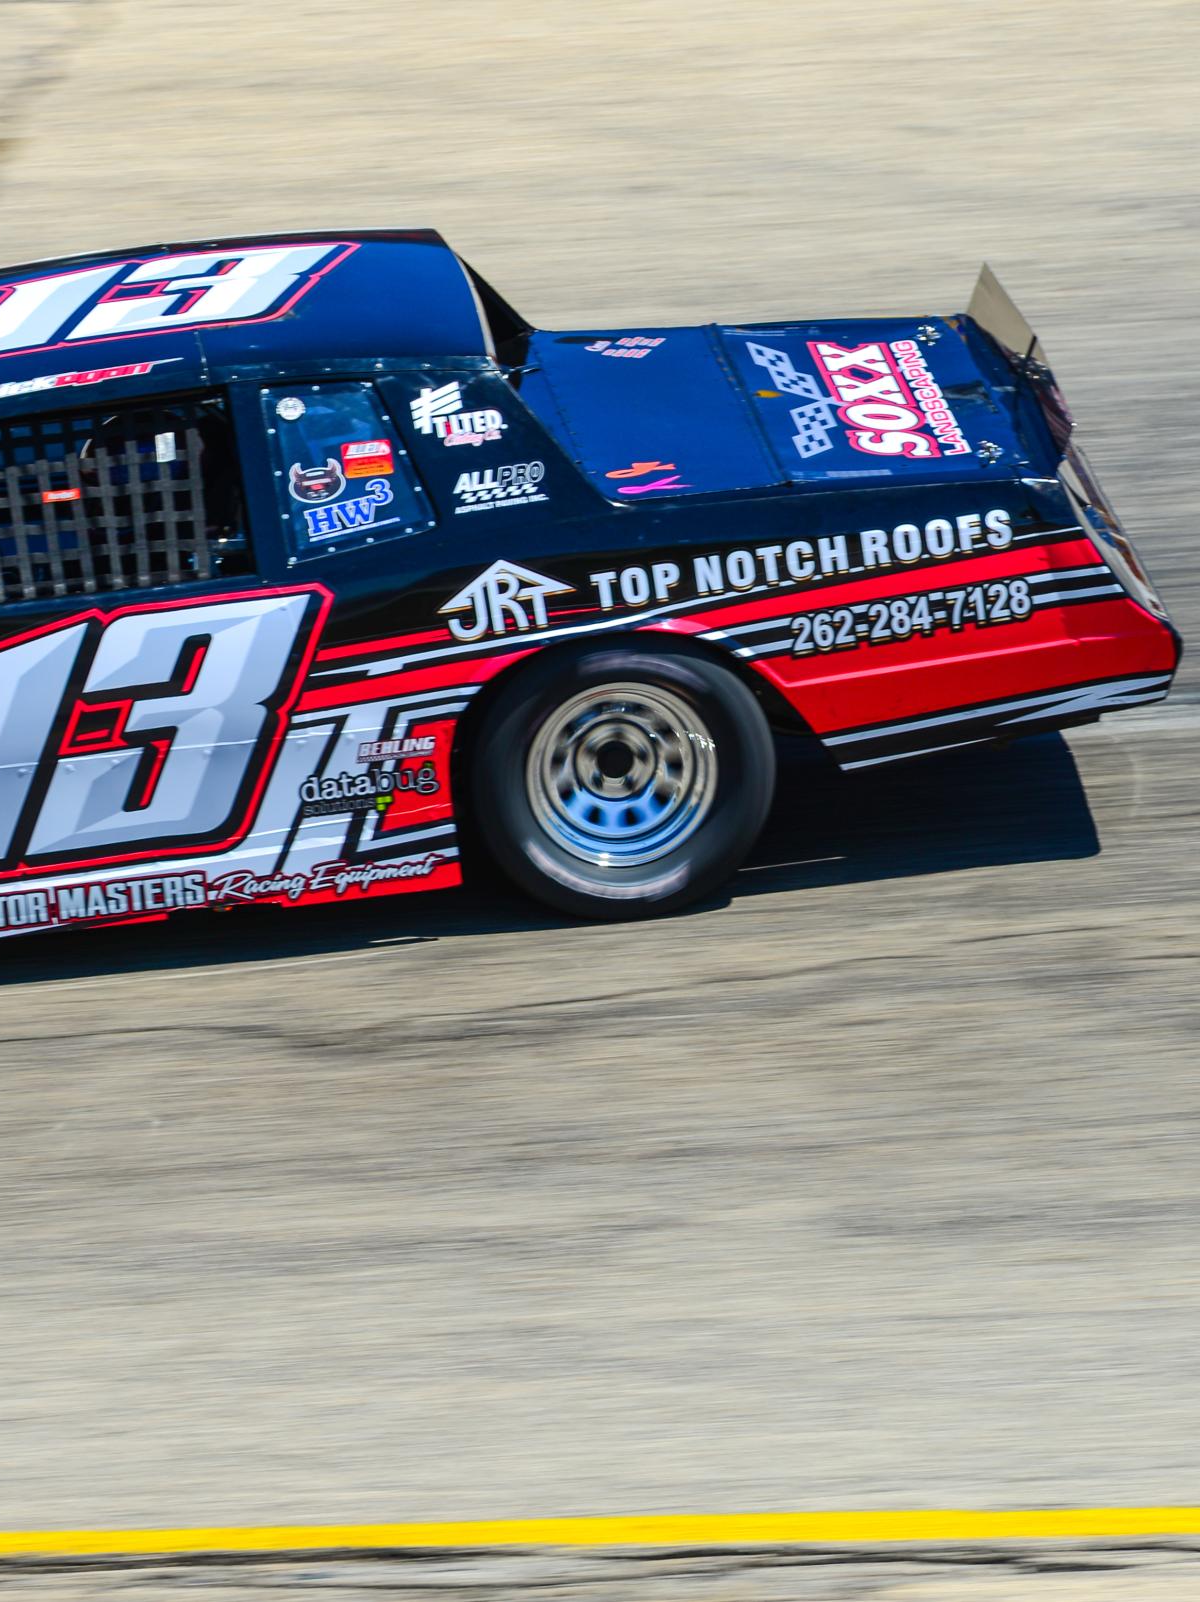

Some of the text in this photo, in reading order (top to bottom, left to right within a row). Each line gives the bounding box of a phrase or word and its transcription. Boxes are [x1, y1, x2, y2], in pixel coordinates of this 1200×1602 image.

[806, 341, 942, 458] SOXX
[889, 340, 972, 456] LANDSCAPING
[589, 508, 1014, 612] TOP NOTCH ROOFS
[445, 562, 560, 641] JRT
[790, 578, 1032, 657] 262-284-7128
[300, 762, 440, 803] databug
[303, 798, 377, 815] solutions
[56, 873, 206, 920] MASTERS
[212, 871, 308, 900] Racing
[310, 855, 446, 894] Equipment
